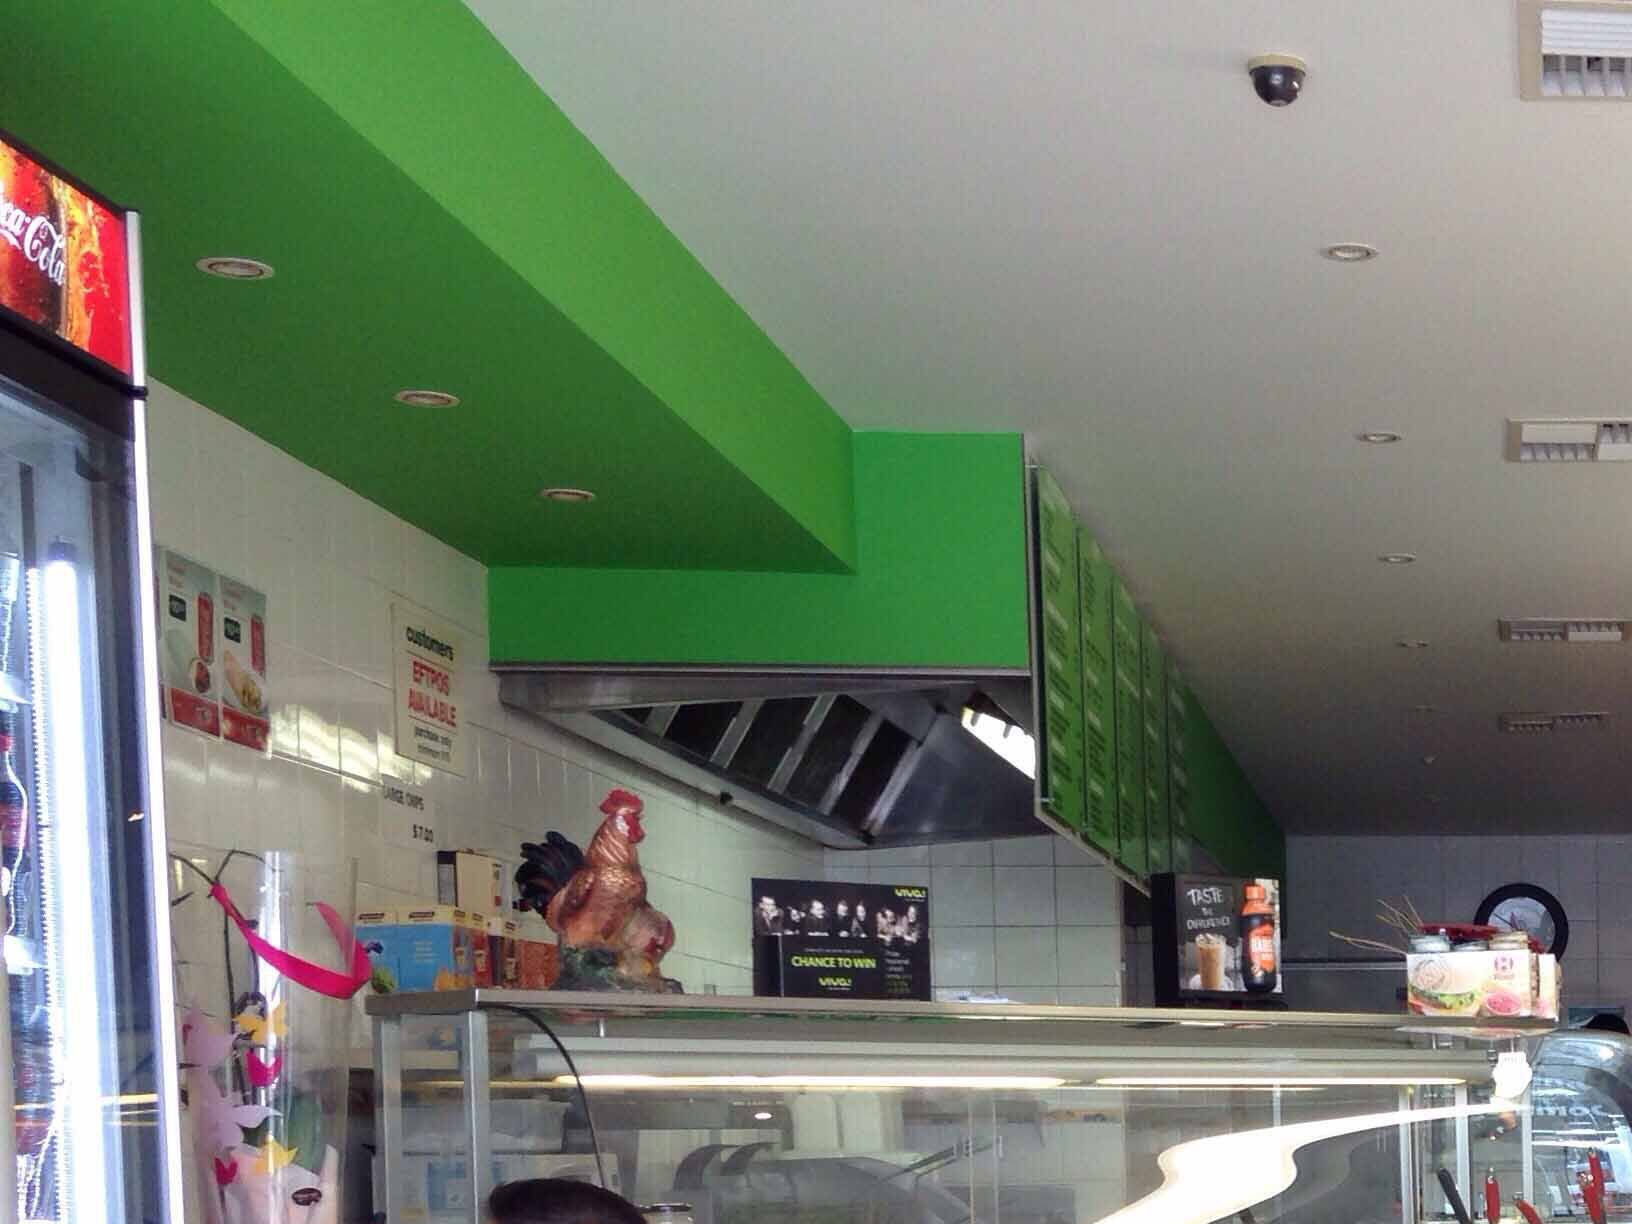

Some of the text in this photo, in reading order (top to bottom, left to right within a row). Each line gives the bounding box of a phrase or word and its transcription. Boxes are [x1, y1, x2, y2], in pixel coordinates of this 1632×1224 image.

[406, 626, 454, 661] customers
[412, 660, 449, 696] EFTPOS
[407, 687, 457, 728] AVAILABLE
[1186, 886, 1224, 906] TASTE
[791, 956, 877, 969] CHANCE TO WIN
